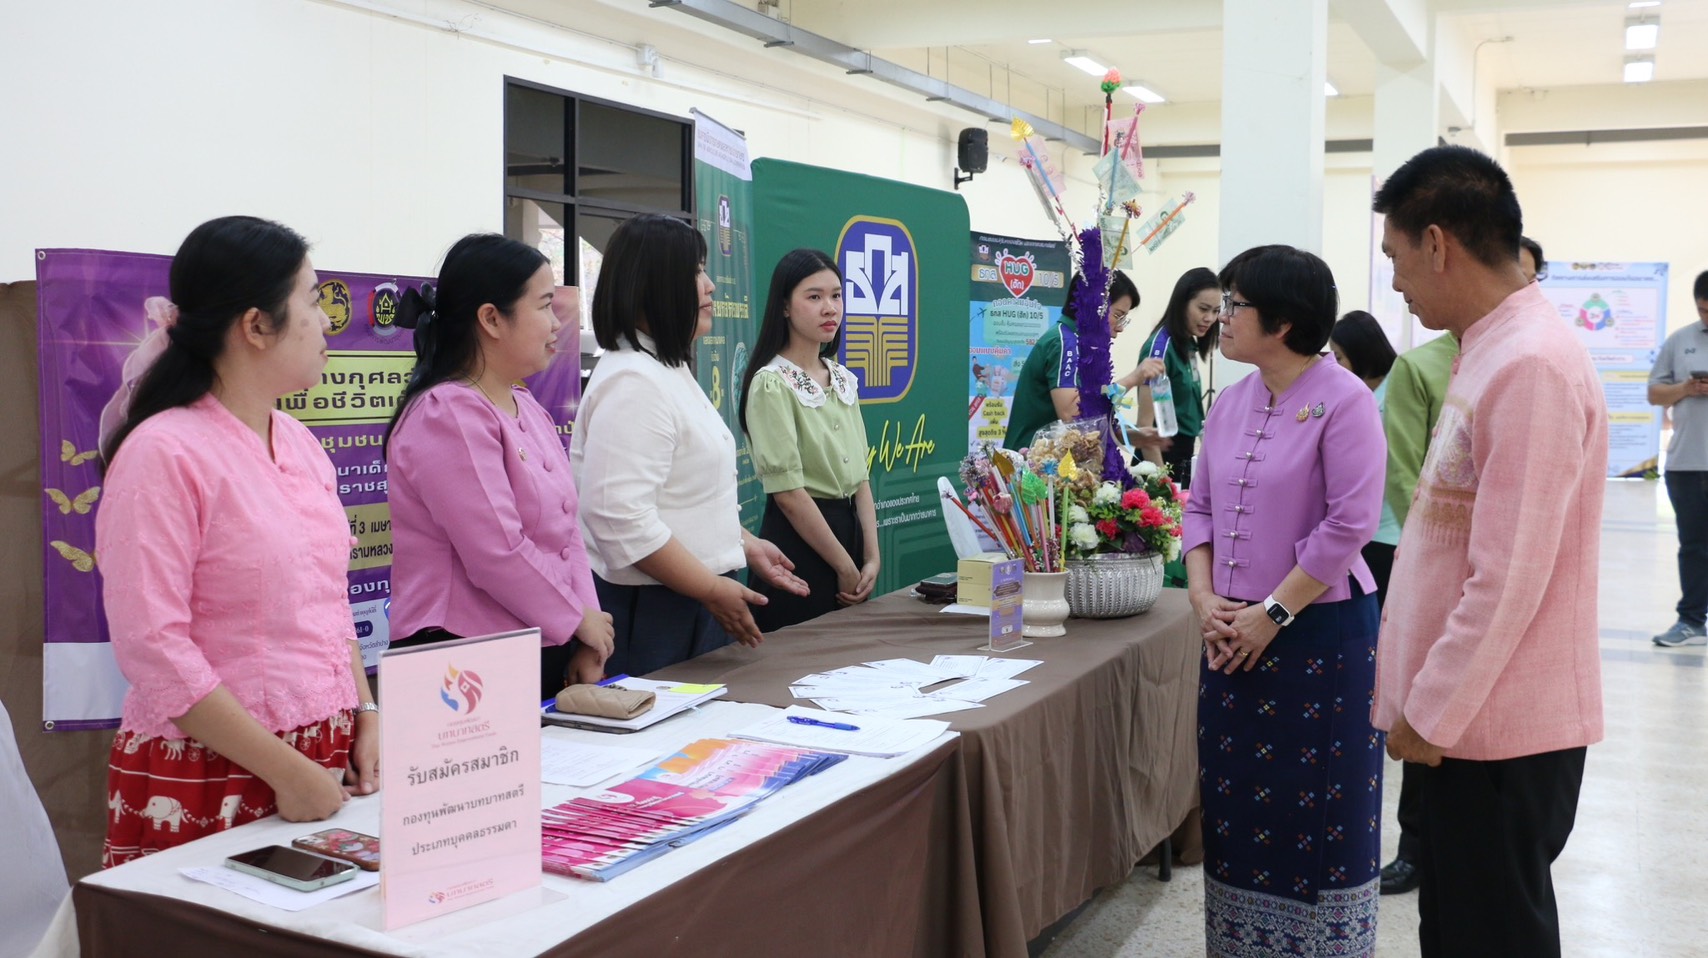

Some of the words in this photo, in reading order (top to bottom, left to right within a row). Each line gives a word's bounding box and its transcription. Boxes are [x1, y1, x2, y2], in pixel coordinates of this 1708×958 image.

[1004, 260, 1030, 275] HUG
[1002, 310, 1016, 318] HUG
[1030, 311, 1043, 319] 10/5
[1064, 350, 1073, 377] BAAC
[879, 419, 904, 472] We
[905, 413, 935, 473] Are
[359, 521, 365, 534] 3
[407, 745, 519, 786] รับสมัครสมาชิก
[402, 784, 525, 827] กองทุนพัฒนาบทบาทสตรี
[411, 819, 517, 856] ประเภทบุคคลธรรมดา
